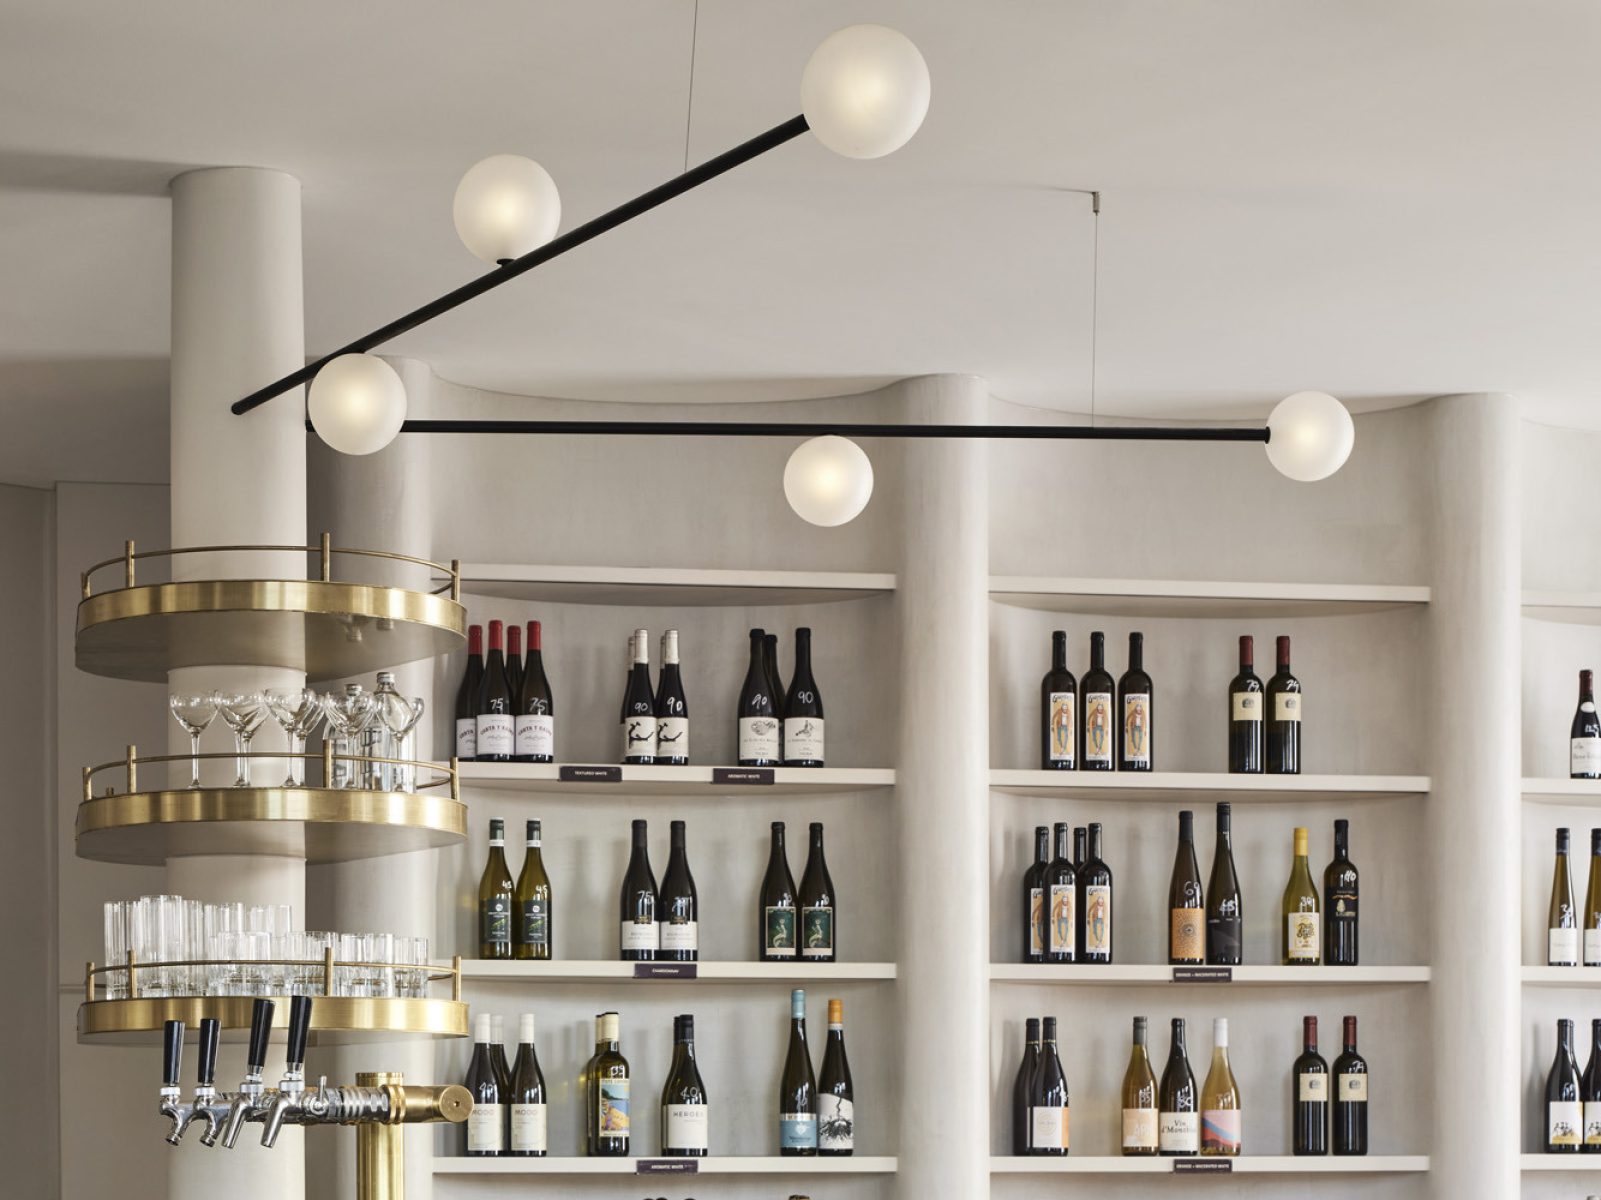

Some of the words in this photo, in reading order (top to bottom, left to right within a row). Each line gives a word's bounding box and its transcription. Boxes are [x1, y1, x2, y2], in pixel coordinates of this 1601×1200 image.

[798, 691, 814, 704] 90
[634, 702, 648, 713] 90
[666, 696, 683, 714] 90
